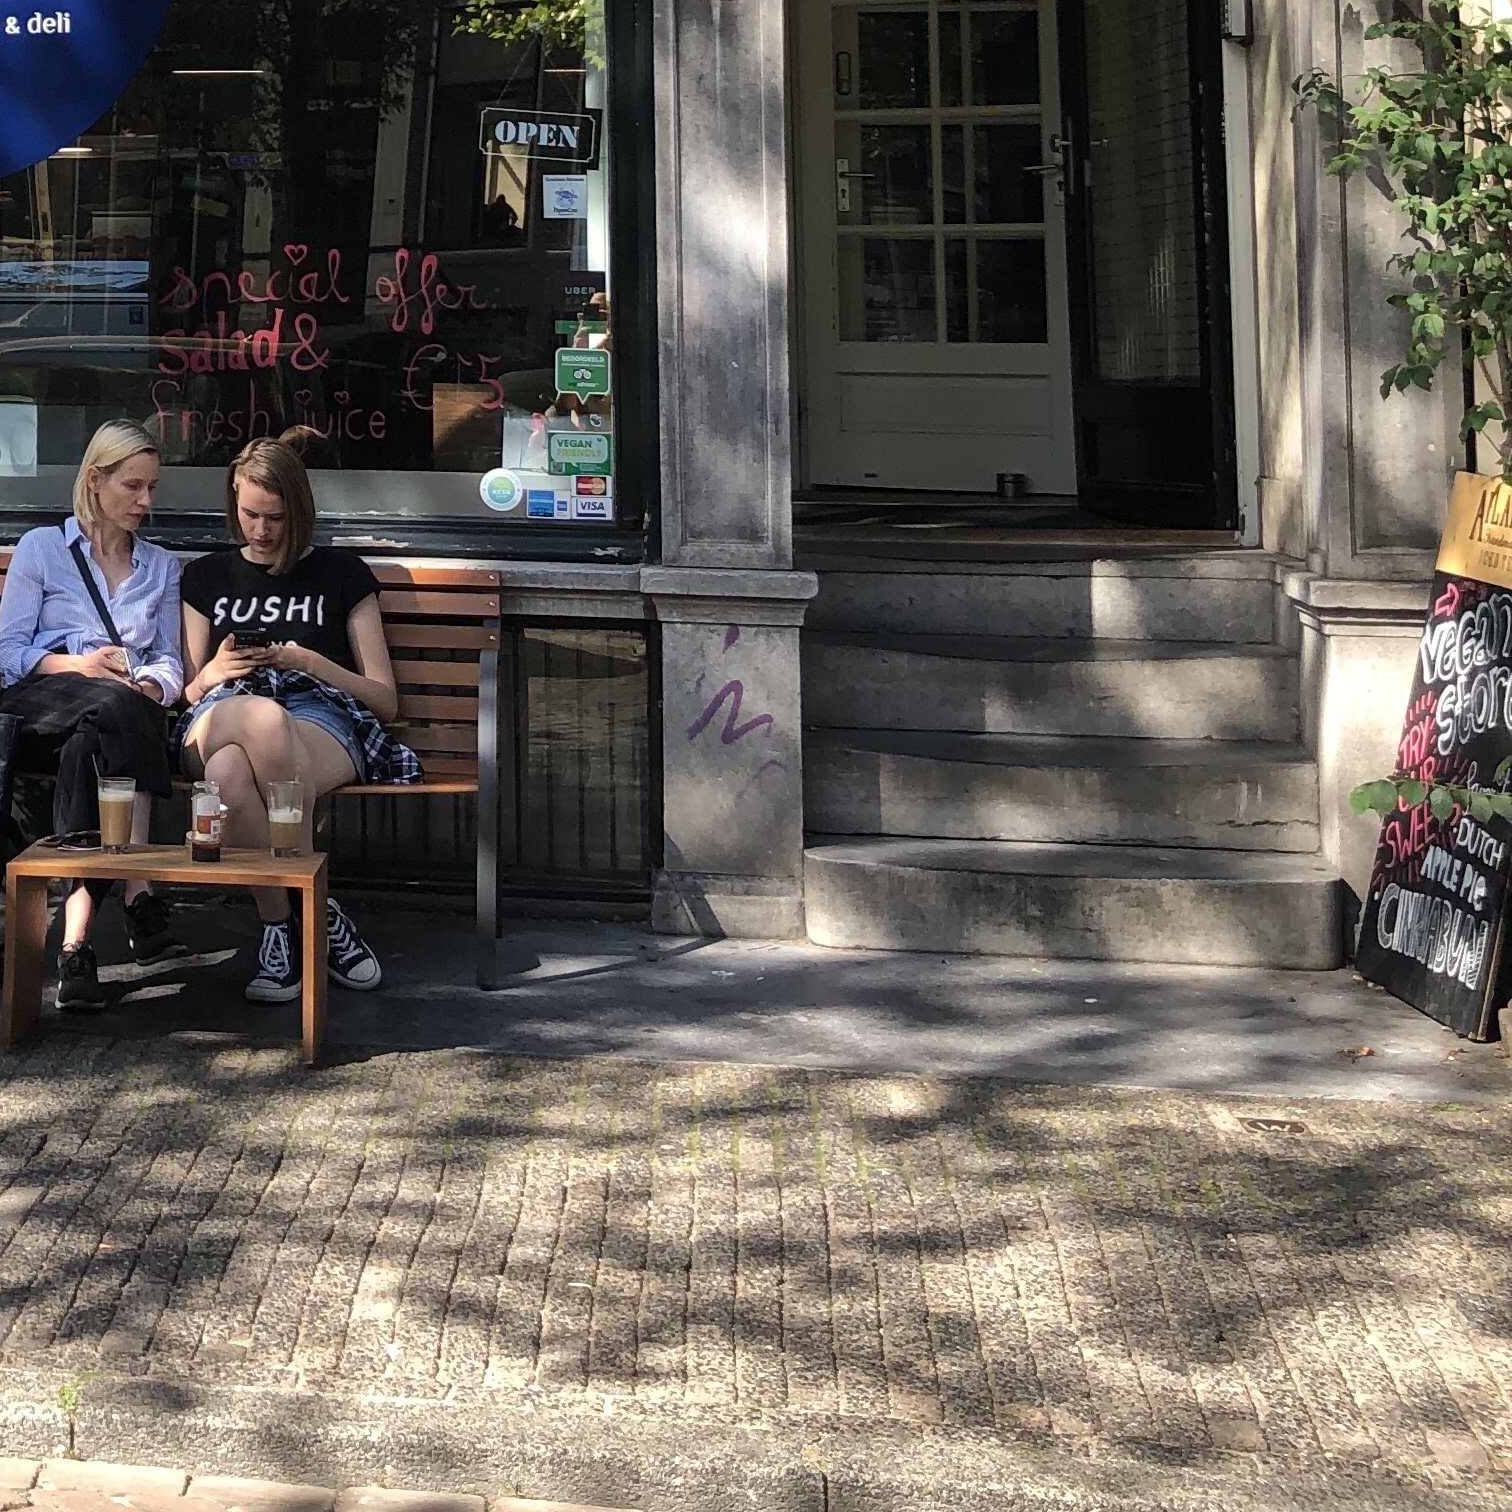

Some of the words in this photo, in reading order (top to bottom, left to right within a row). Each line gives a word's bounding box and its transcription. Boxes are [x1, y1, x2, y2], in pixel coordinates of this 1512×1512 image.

[5, 17, 21, 34] &
[26, 11, 71, 34] deli
[495, 121, 580, 148] OPEN
[565, 286, 596, 295] UBER
[158, 308, 284, 375] salad
[290, 313, 330, 370] &
[149, 380, 270, 444] fresh
[295, 389, 386, 441] juice
[556, 439, 592, 448] VEGAN
[557, 448, 601, 457] FRIENDLY
[580, 501, 605, 510] VISA
[213, 595, 324, 626] SUSHI
[1399, 715, 1431, 770] TRY
[1456, 817, 1505, 870] DUTCH
[1420, 844, 1463, 893] APPLE
